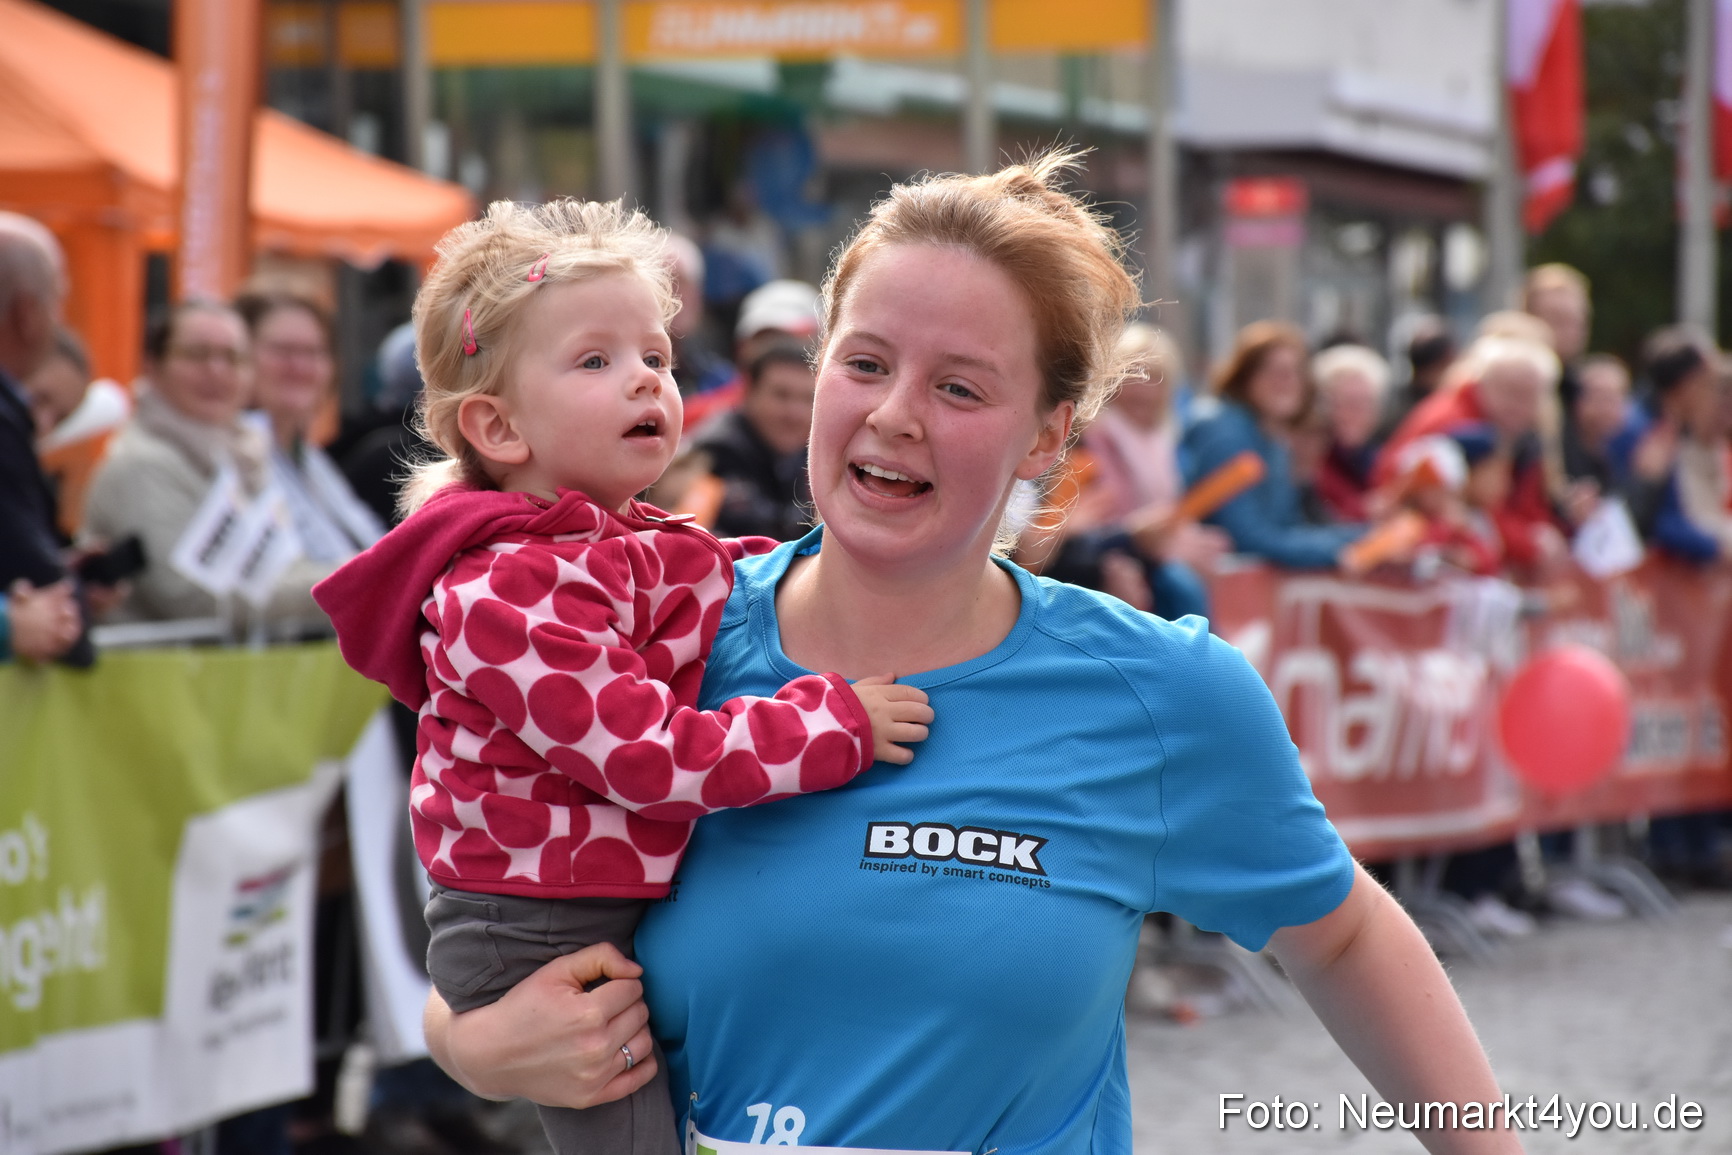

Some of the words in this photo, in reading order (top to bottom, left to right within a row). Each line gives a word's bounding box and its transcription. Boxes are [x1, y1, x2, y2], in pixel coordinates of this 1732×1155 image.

[868, 825, 1041, 871] BOCK
[859, 859, 917, 873] inspired
[921, 863, 939, 876] by
[943, 866, 985, 880] smart
[988, 872, 1051, 889] concepts
